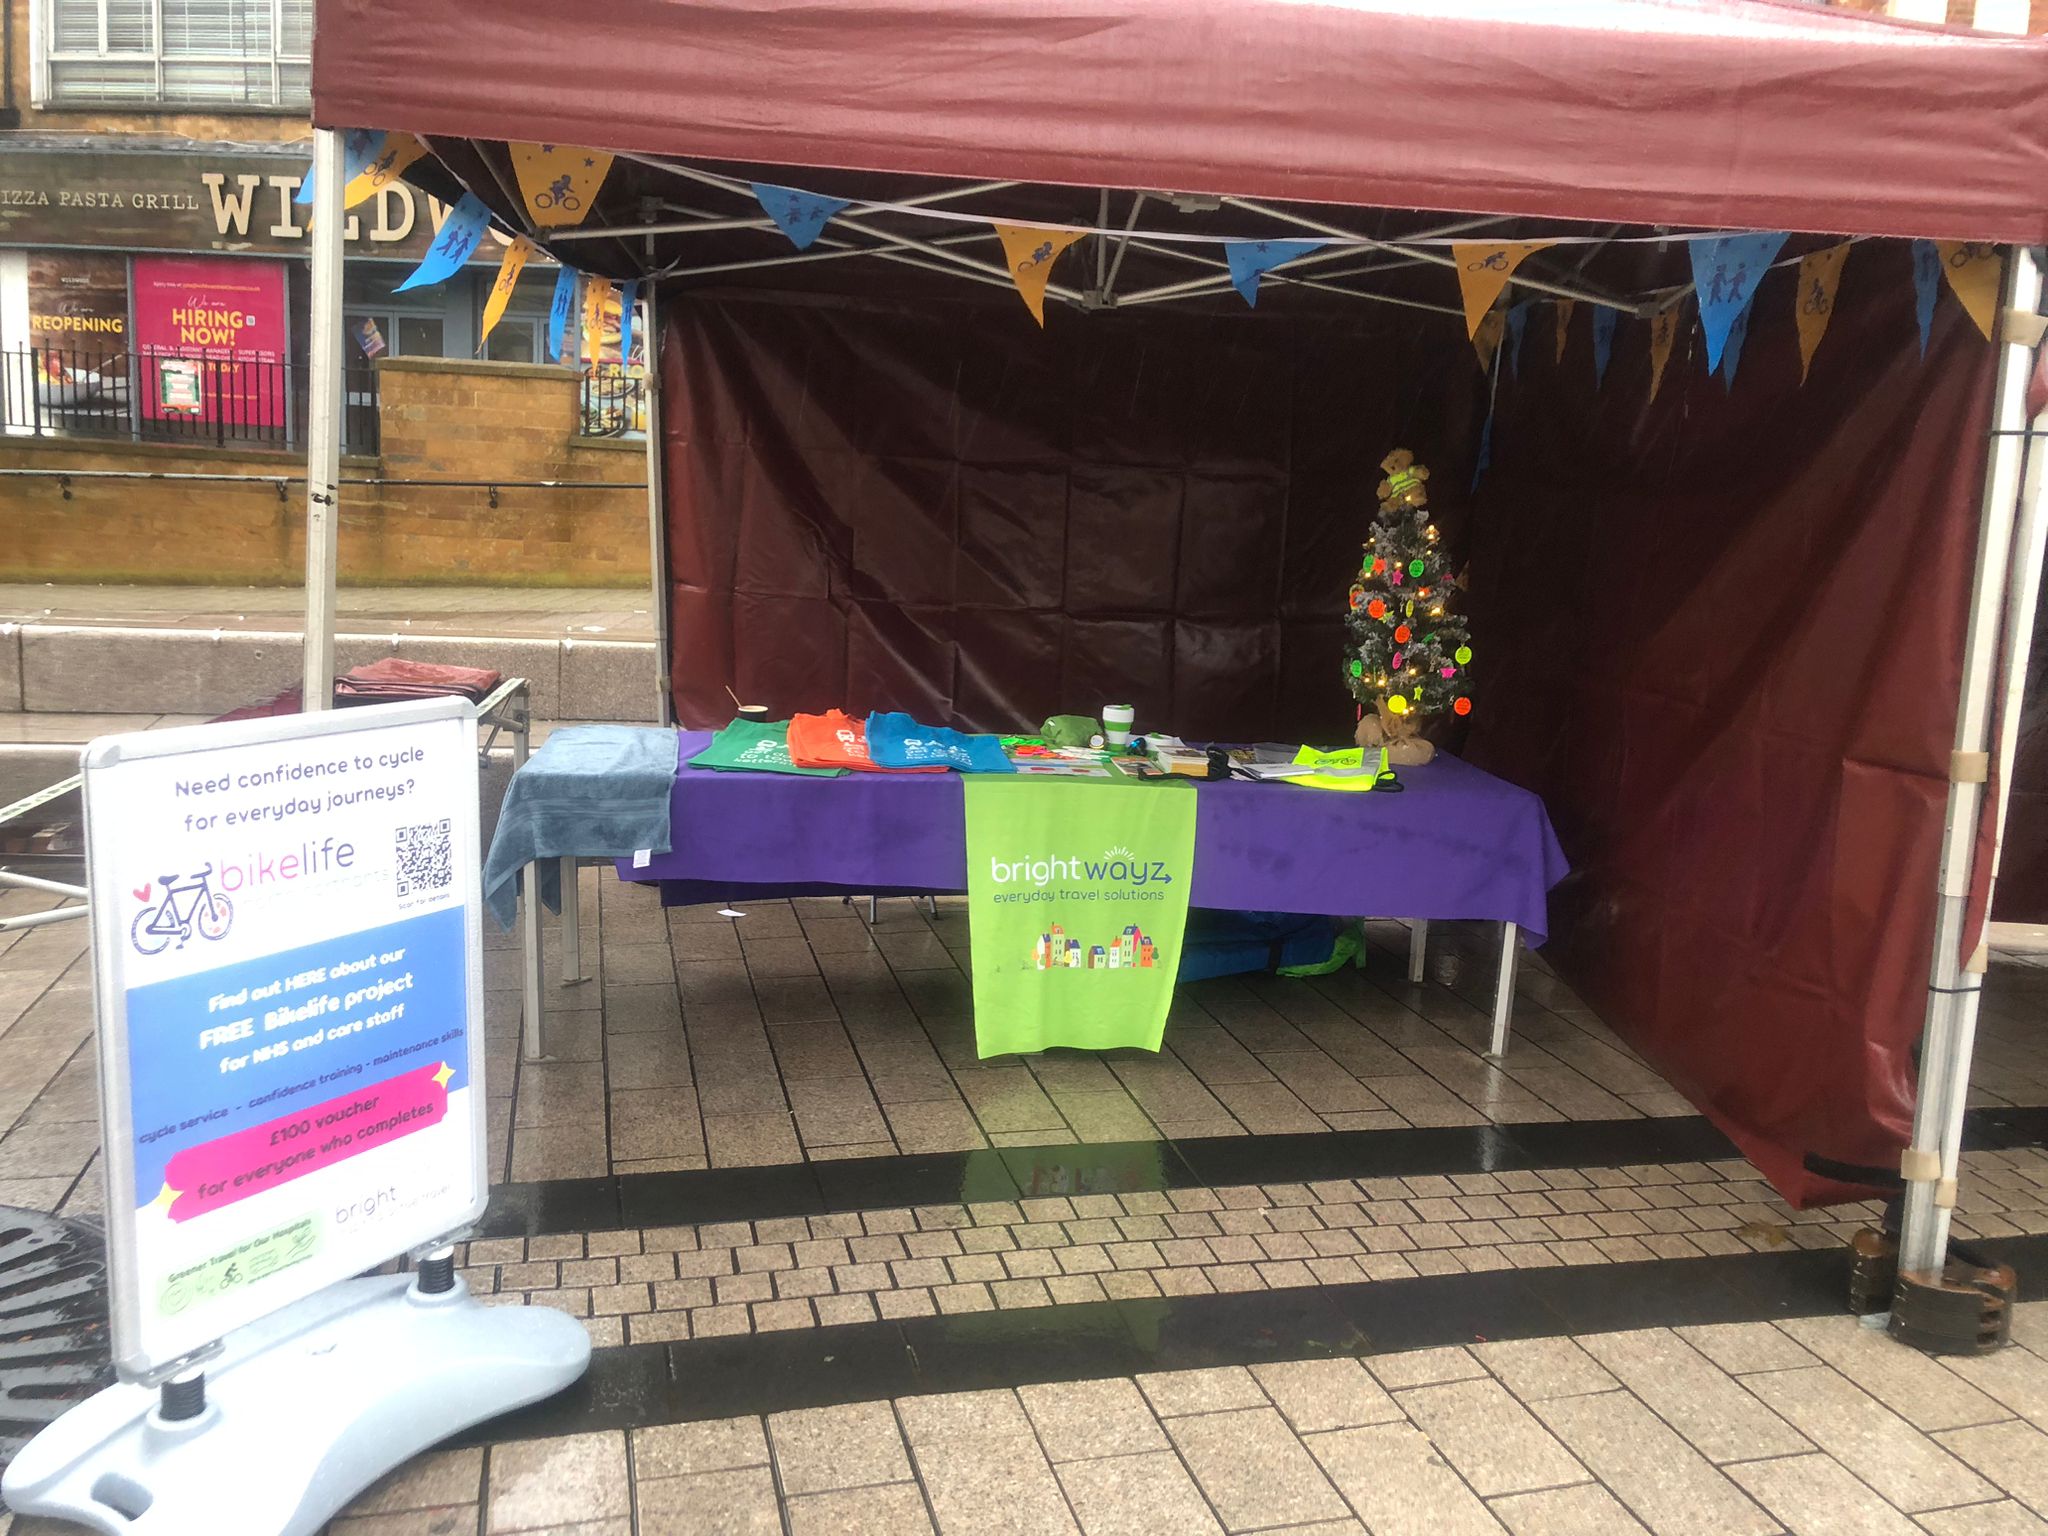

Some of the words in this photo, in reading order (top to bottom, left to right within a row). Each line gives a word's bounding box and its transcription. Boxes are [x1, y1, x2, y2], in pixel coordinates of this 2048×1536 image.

[59, 191, 125, 208] PASTA
[132, 193, 200, 210] GRILL
[31, 315, 123, 333] REOPENING
[172, 308, 243, 329] HIRING
[181, 326, 235, 347] NOW!
[238, 349, 275, 357] SUPERISORS
[175, 773, 231, 797] Need
[237, 759, 348, 789] confidence
[354, 755, 373, 771] to
[379, 746, 424, 768] cycle
[184, 814, 218, 832] for
[225, 798, 321, 826] everyday
[327, 778, 415, 811] journeys?
[220, 838, 354, 891] bikelife
[991, 854, 1171, 887] brightwayz
[994, 889, 1055, 904] everyday
[1059, 889, 1099, 901] travel
[1104, 889, 1164, 902] solutions
[208, 987, 248, 1013] Find
[251, 980, 282, 1001] out
[285, 967, 327, 992] HERE
[329, 954, 377, 979] about
[379, 948, 406, 965] our
[199, 1017, 255, 1050] FREE
[264, 994, 340, 1031] Bikelife
[344, 972, 414, 1011] project
[219, 1054, 250, 1073] for
[253, 1040, 289, 1064] NHS
[292, 1028, 324, 1051] and
[327, 1020, 363, 1041] care
[366, 1003, 405, 1029] staff
[138, 1123, 177, 1145] cycle
[179, 1106, 229, 1131] service
[248, 1078, 316, 1109] confidence
[318, 1061, 363, 1085] training
[373, 1038, 439, 1066] maintenance
[441, 1027, 464, 1047] skills
[269, 1120, 311, 1147] £100
[315, 1095, 380, 1129] voucher
[198, 1178, 228, 1200] for
[233, 1147, 317, 1188] everyone
[320, 1130, 353, 1153] who
[357, 1102, 435, 1141] completes
[335, 1186, 398, 1225] bright
[168, 1262, 207, 1283] Greener
[254, 1235, 271, 1248] Our
